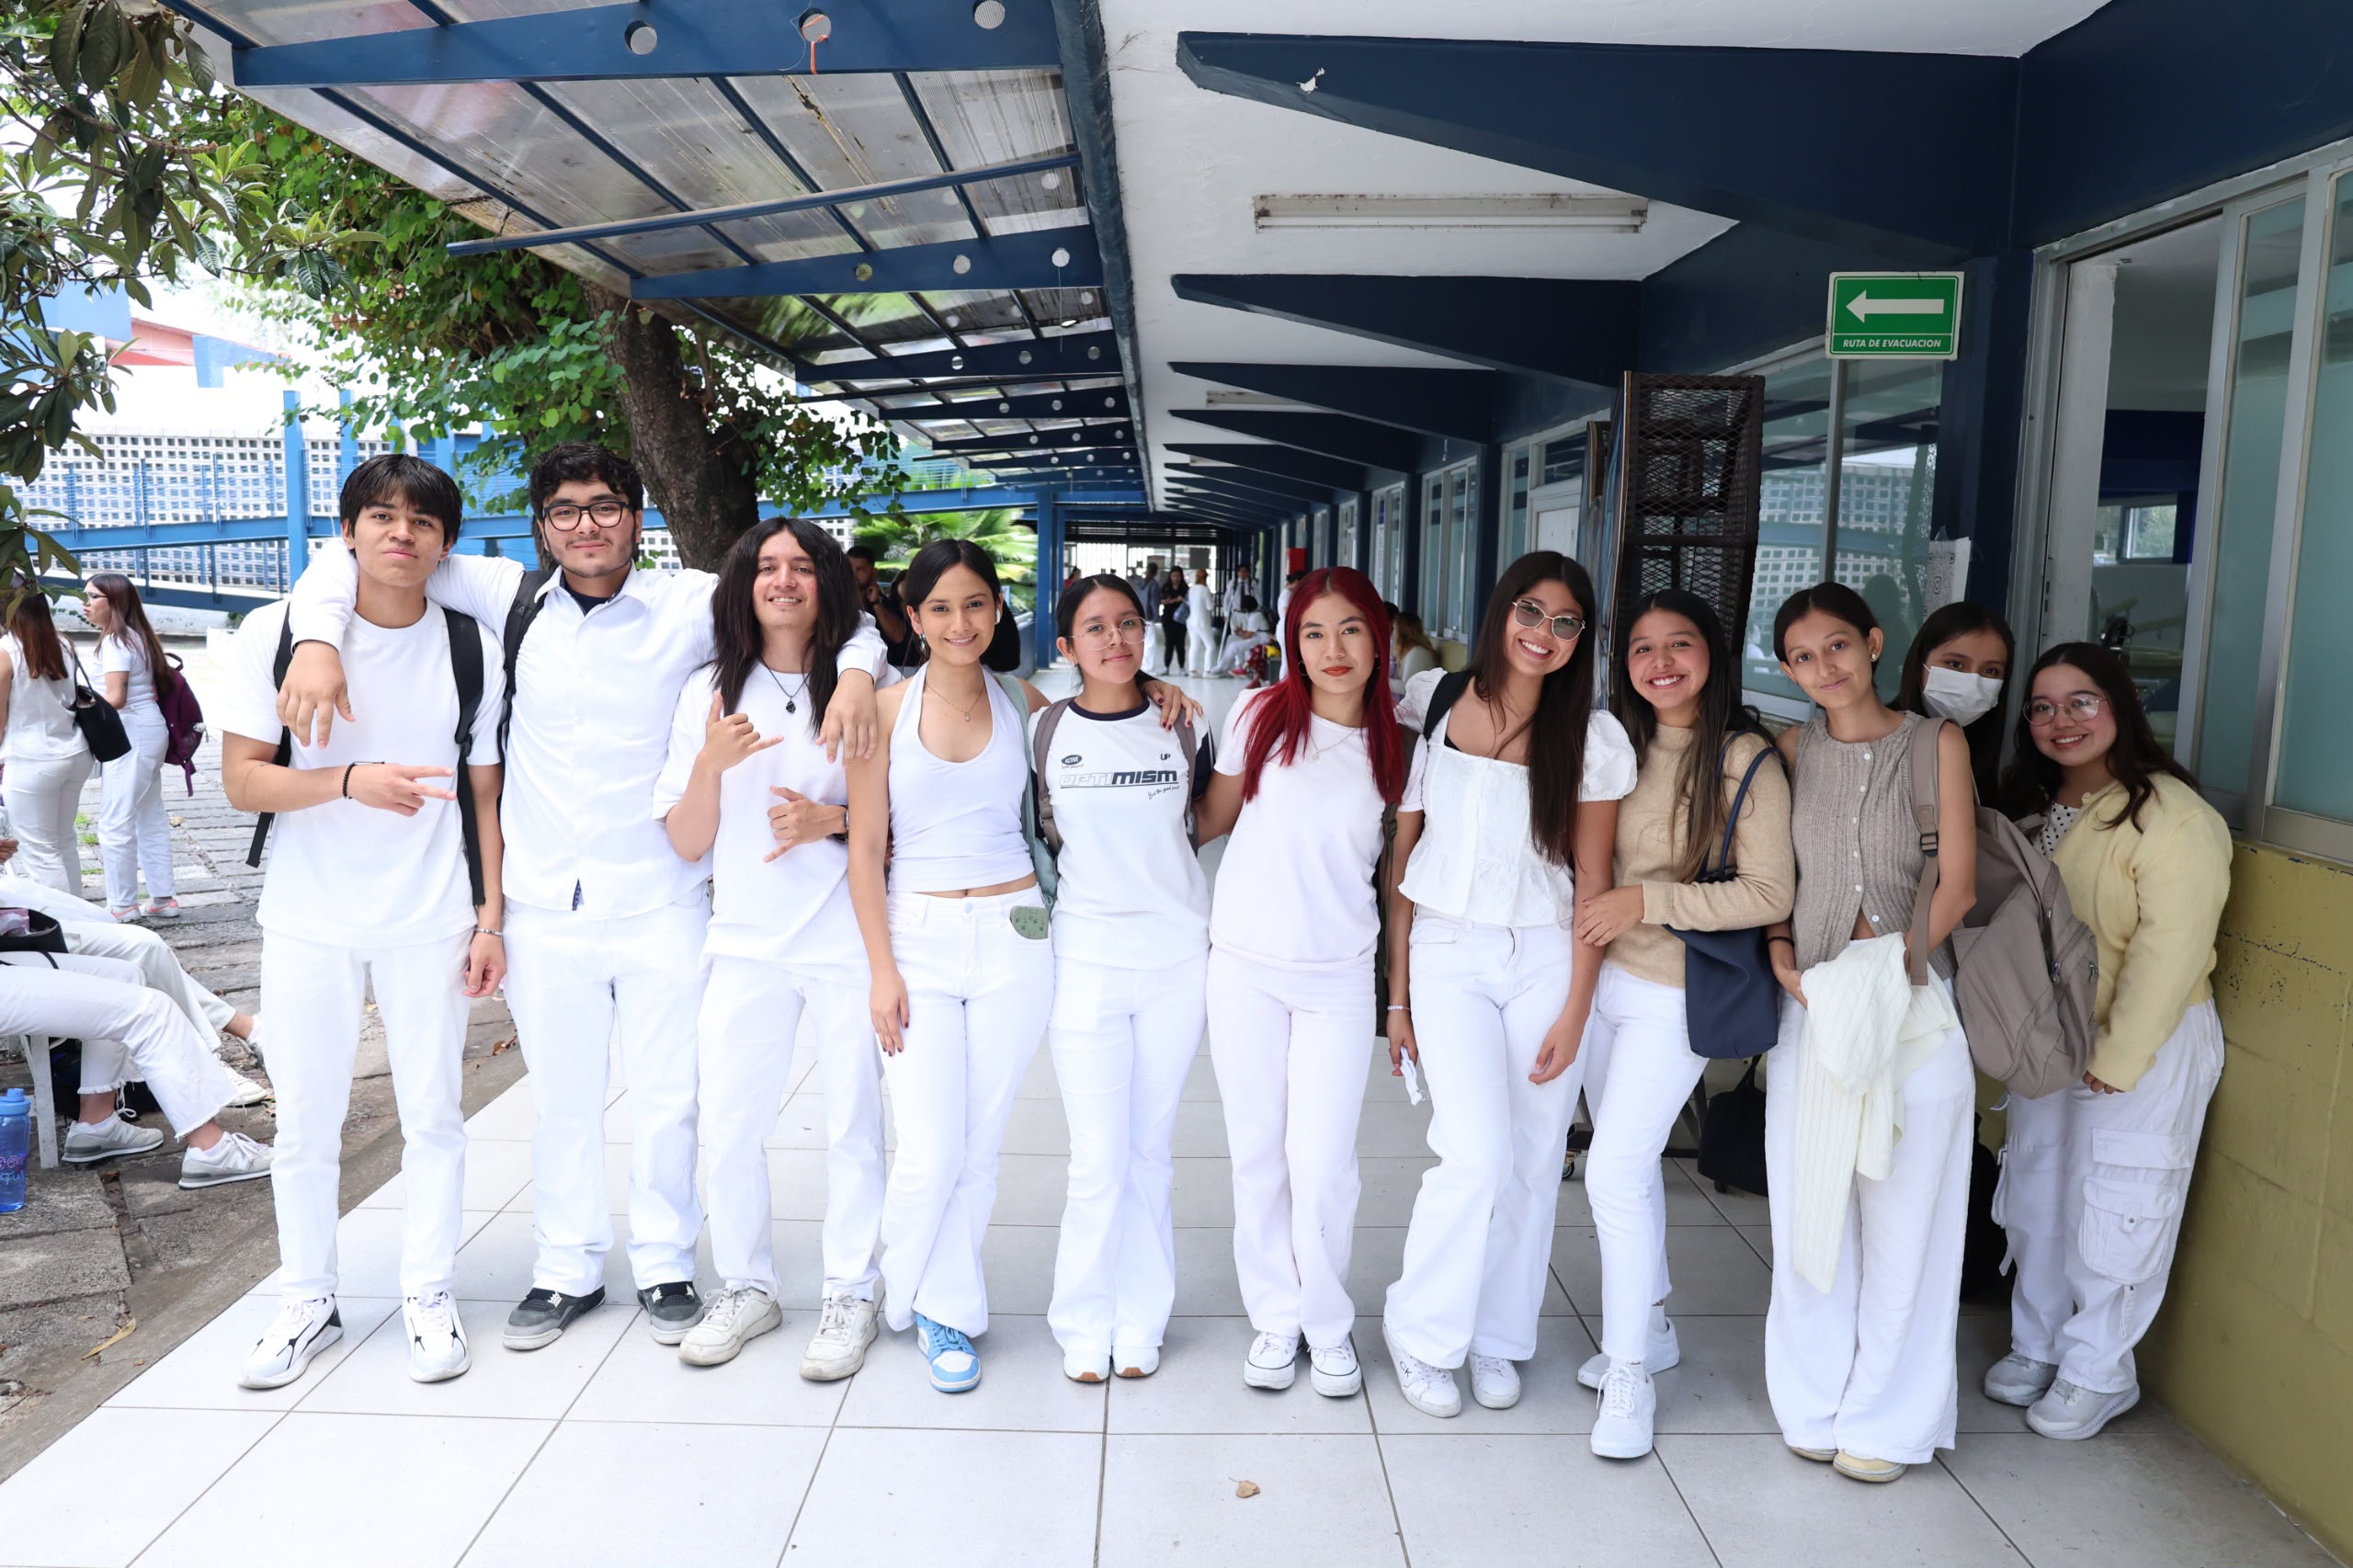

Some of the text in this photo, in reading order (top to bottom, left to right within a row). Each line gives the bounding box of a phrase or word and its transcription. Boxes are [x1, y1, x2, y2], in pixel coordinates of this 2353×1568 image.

[1843, 339, 1941, 347] RUTA DE EVACUACION
[1399, 1361, 1412, 1378] CK
